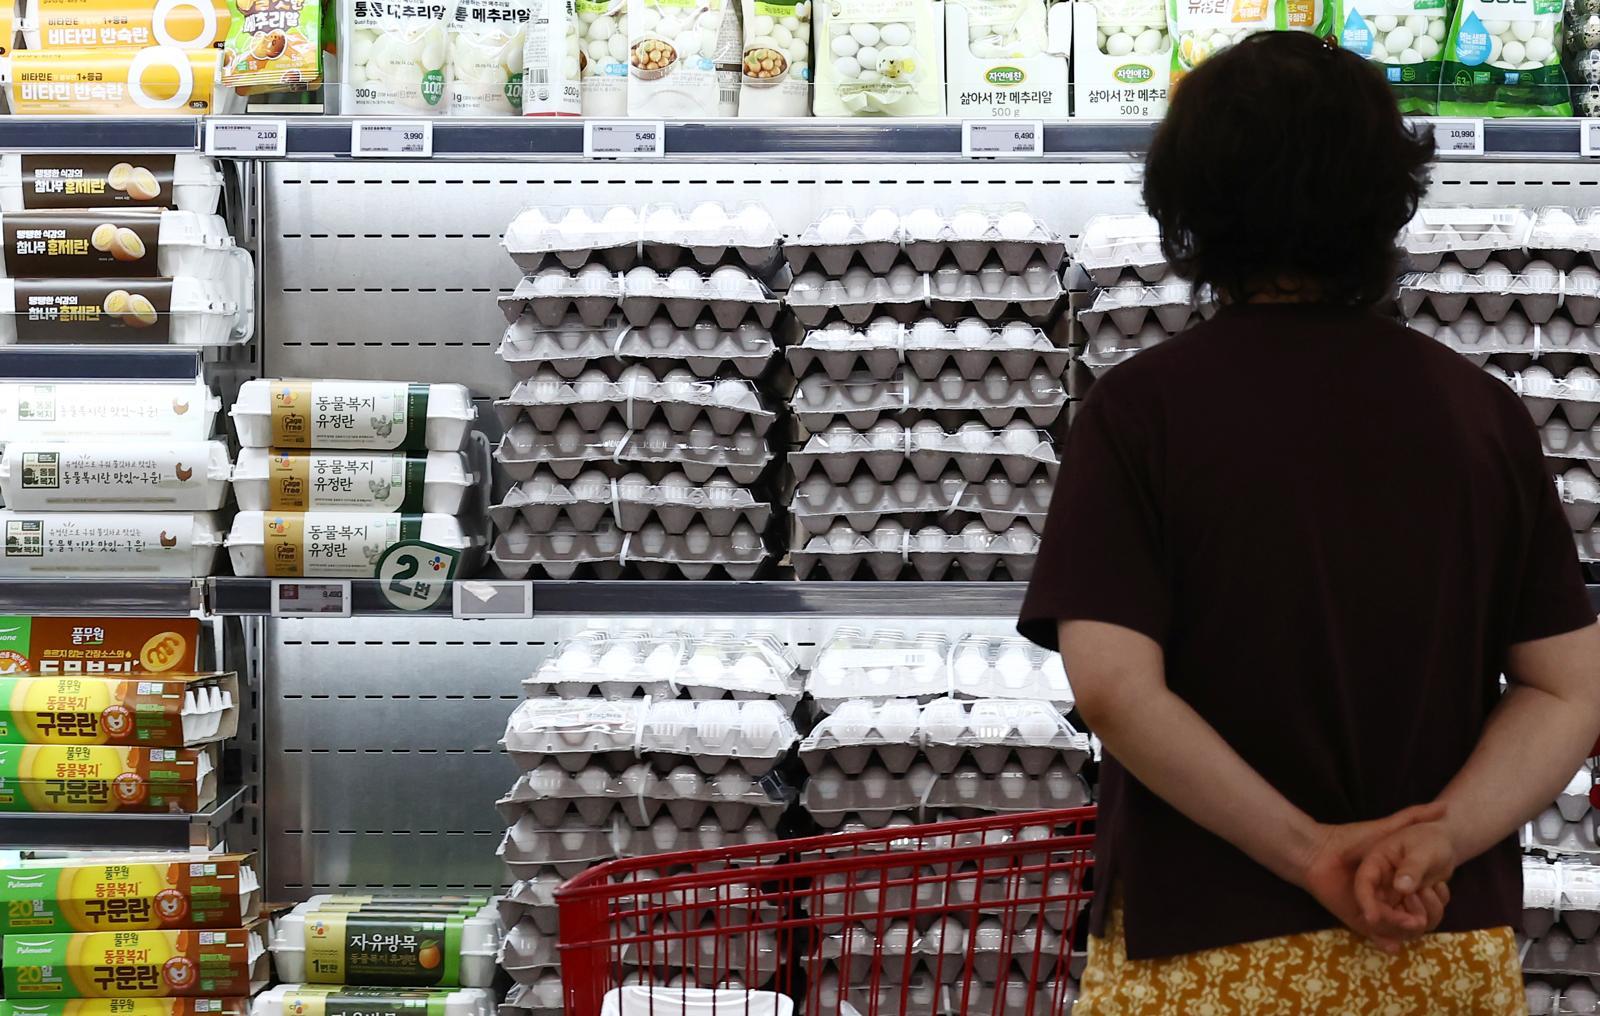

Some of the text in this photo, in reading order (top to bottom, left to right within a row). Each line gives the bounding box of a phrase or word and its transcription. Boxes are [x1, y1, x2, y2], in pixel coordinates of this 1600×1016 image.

[472, 8, 531, 23] 메추리알
[48, 27, 149, 45] 비타민 반숙란
[21, 72, 103, 81] 비타민E 1+등급
[21, 83, 123, 100] 비타민 반숙란
[960, 90, 1053, 105] 삶아서 깐 메추리알
[1088, 88, 1167, 103] 삶아서 깐 메추리
[992, 107, 1011, 117] 500
[1120, 105, 1139, 115] 500
[257, 131, 278, 140] 2,100
[403, 132, 424, 140] 3,990
[635, 133, 656, 141] 5,490
[1014, 132, 1035, 140] 6,490
[1450, 130, 1475, 139] 10,990
[35, 178, 106, 194] 참나무 훈제란
[16, 239, 89, 256] 참나무 훈제란
[28, 305, 101, 321] 참나무 훈제란
[275, 393, 284, 401] CJ
[315, 396, 376, 412] 동물복지
[284, 416, 302, 425] Cage
[315, 413, 356, 429] 유정란
[314, 459, 374, 475] 동물복지
[63, 471, 110, 485] 동물복지란
[282, 479, 301, 488] Cage
[314, 477, 354, 492] 유정란
[308, 524, 369, 541] 동물복지
[308, 542, 348, 558] 유정란
[71, 626, 105, 645] 풀무원
[43, 649, 67, 658] 흐르지
[85, 649, 125, 658] 간장소스와
[57, 679, 82, 694] 풀무원
[46, 696, 88, 711] 동물복지
[36, 712, 98, 737] 구운란
[66, 746, 91, 761] 풀무원
[56, 763, 99, 778] 동물복지
[45, 779, 110, 804] 구운란
[104, 865, 129, 880] 풀무원
[95, 882, 139, 898] 동물복지
[85, 898, 151, 924] 구운란
[114, 932, 139, 947] 풀무원
[350, 933, 418, 953] 자유방목
[104, 949, 148, 964] 동물복지
[93, 965, 160, 990] 구운란
[110, 999, 134, 1013] 풀무원
